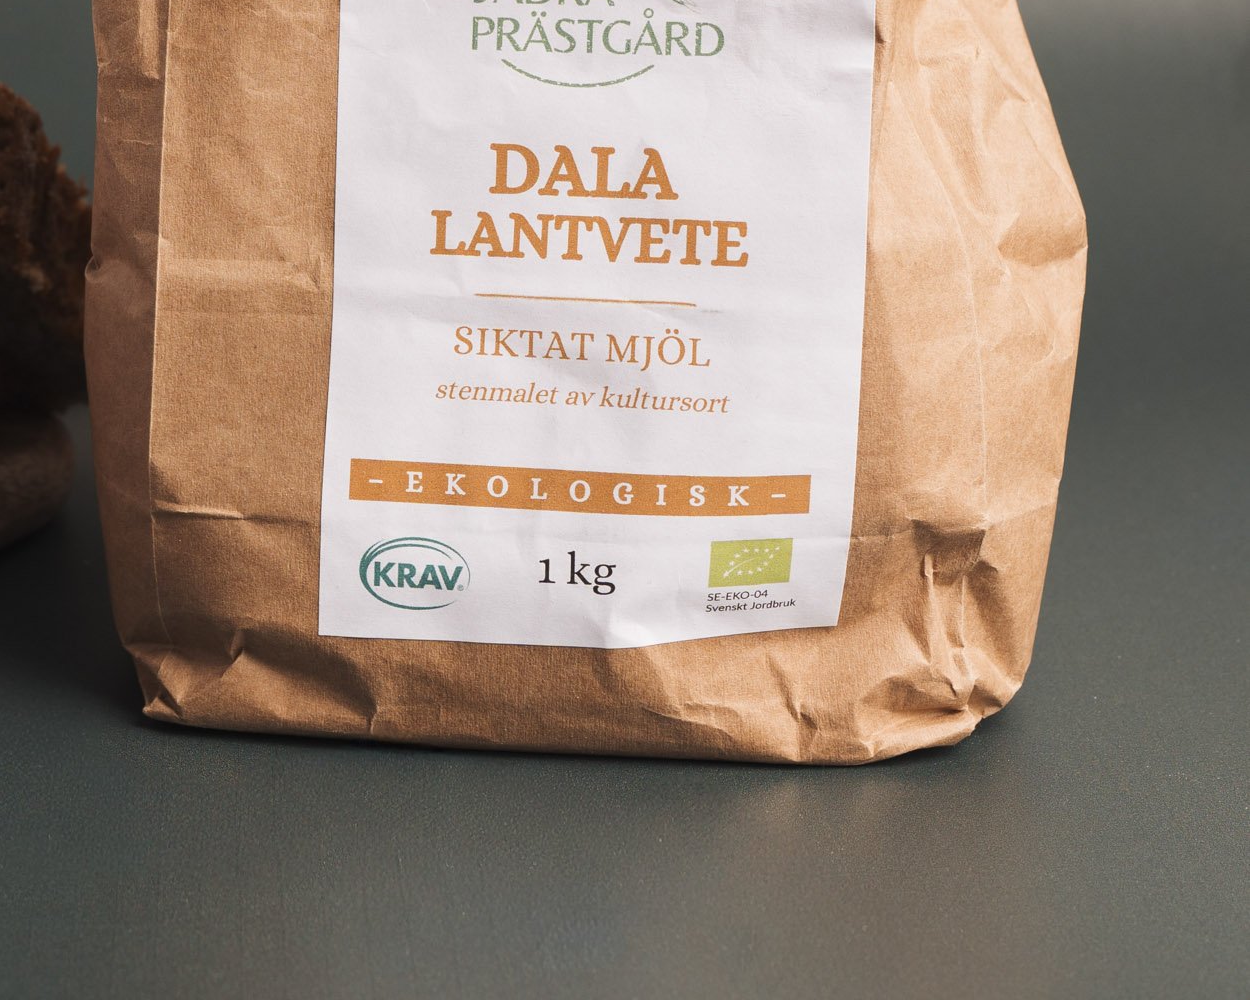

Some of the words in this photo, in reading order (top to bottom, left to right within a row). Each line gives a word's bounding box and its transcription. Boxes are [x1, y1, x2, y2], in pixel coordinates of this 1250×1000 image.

[471, 8, 725, 57] PRÄSTGÅRD
[488, 142, 680, 201] DALA
[429, 209, 749, 268] LANTVETE
[453, 325, 595, 361] SIKTAT
[605, 328, 711, 372] MJÖL
[435, 382, 559, 405] stenmalet
[565, 391, 594, 406] av
[599, 386, 730, 413] kultursort
[538, 558, 556, 584] 1
[566, 550, 617, 596] kg
[707, 589, 769, 602] SE-EKO-04
[705, 603, 748, 613] Svenskt
[750, 598, 796, 610] Jordbruk
